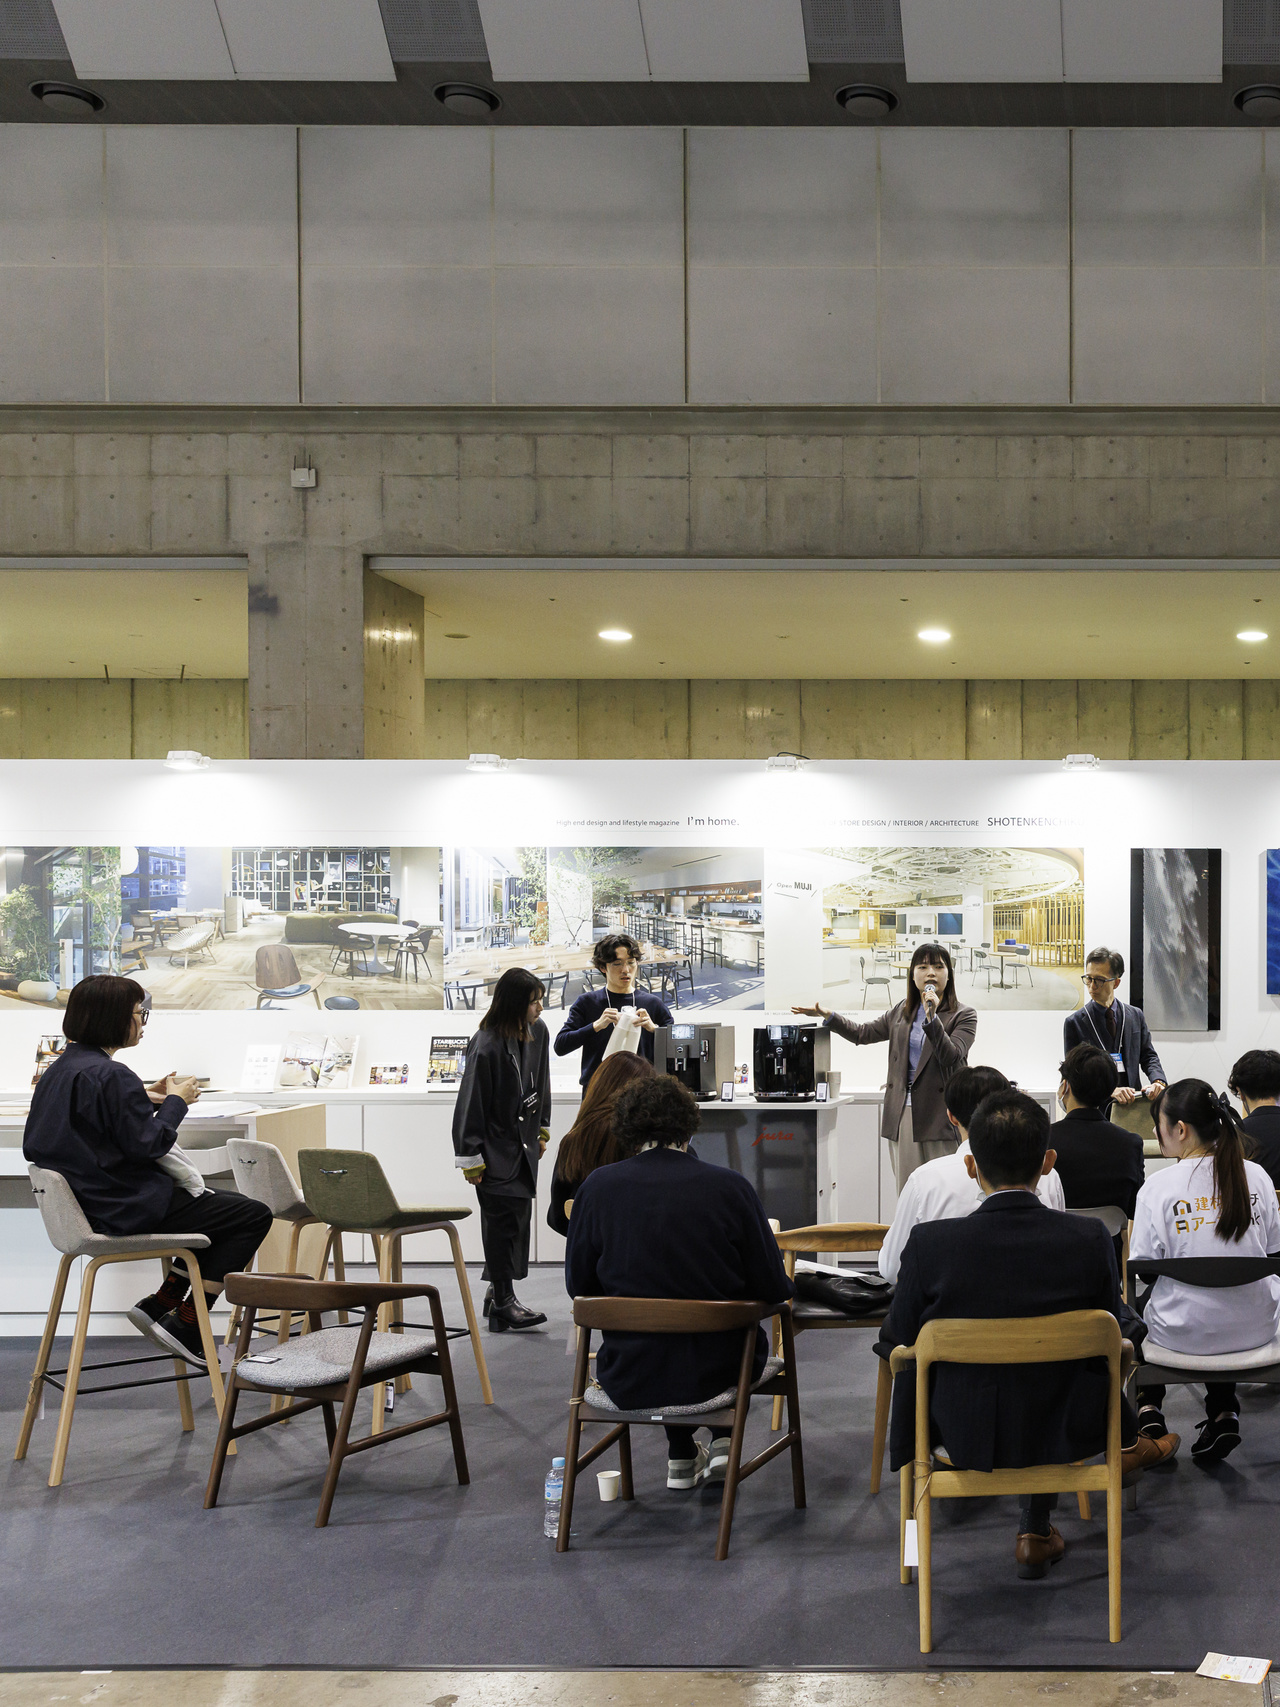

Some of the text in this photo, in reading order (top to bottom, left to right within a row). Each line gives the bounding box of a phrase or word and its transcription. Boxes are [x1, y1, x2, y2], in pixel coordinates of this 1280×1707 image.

[586, 819, 608, 827] design
[622, 819, 648, 827] lifestyle
[687, 816, 705, 826] I'm
[707, 816, 740, 826] home.
[794, 881, 812, 891] MUJI
[751, 1127, 794, 1147] jura
